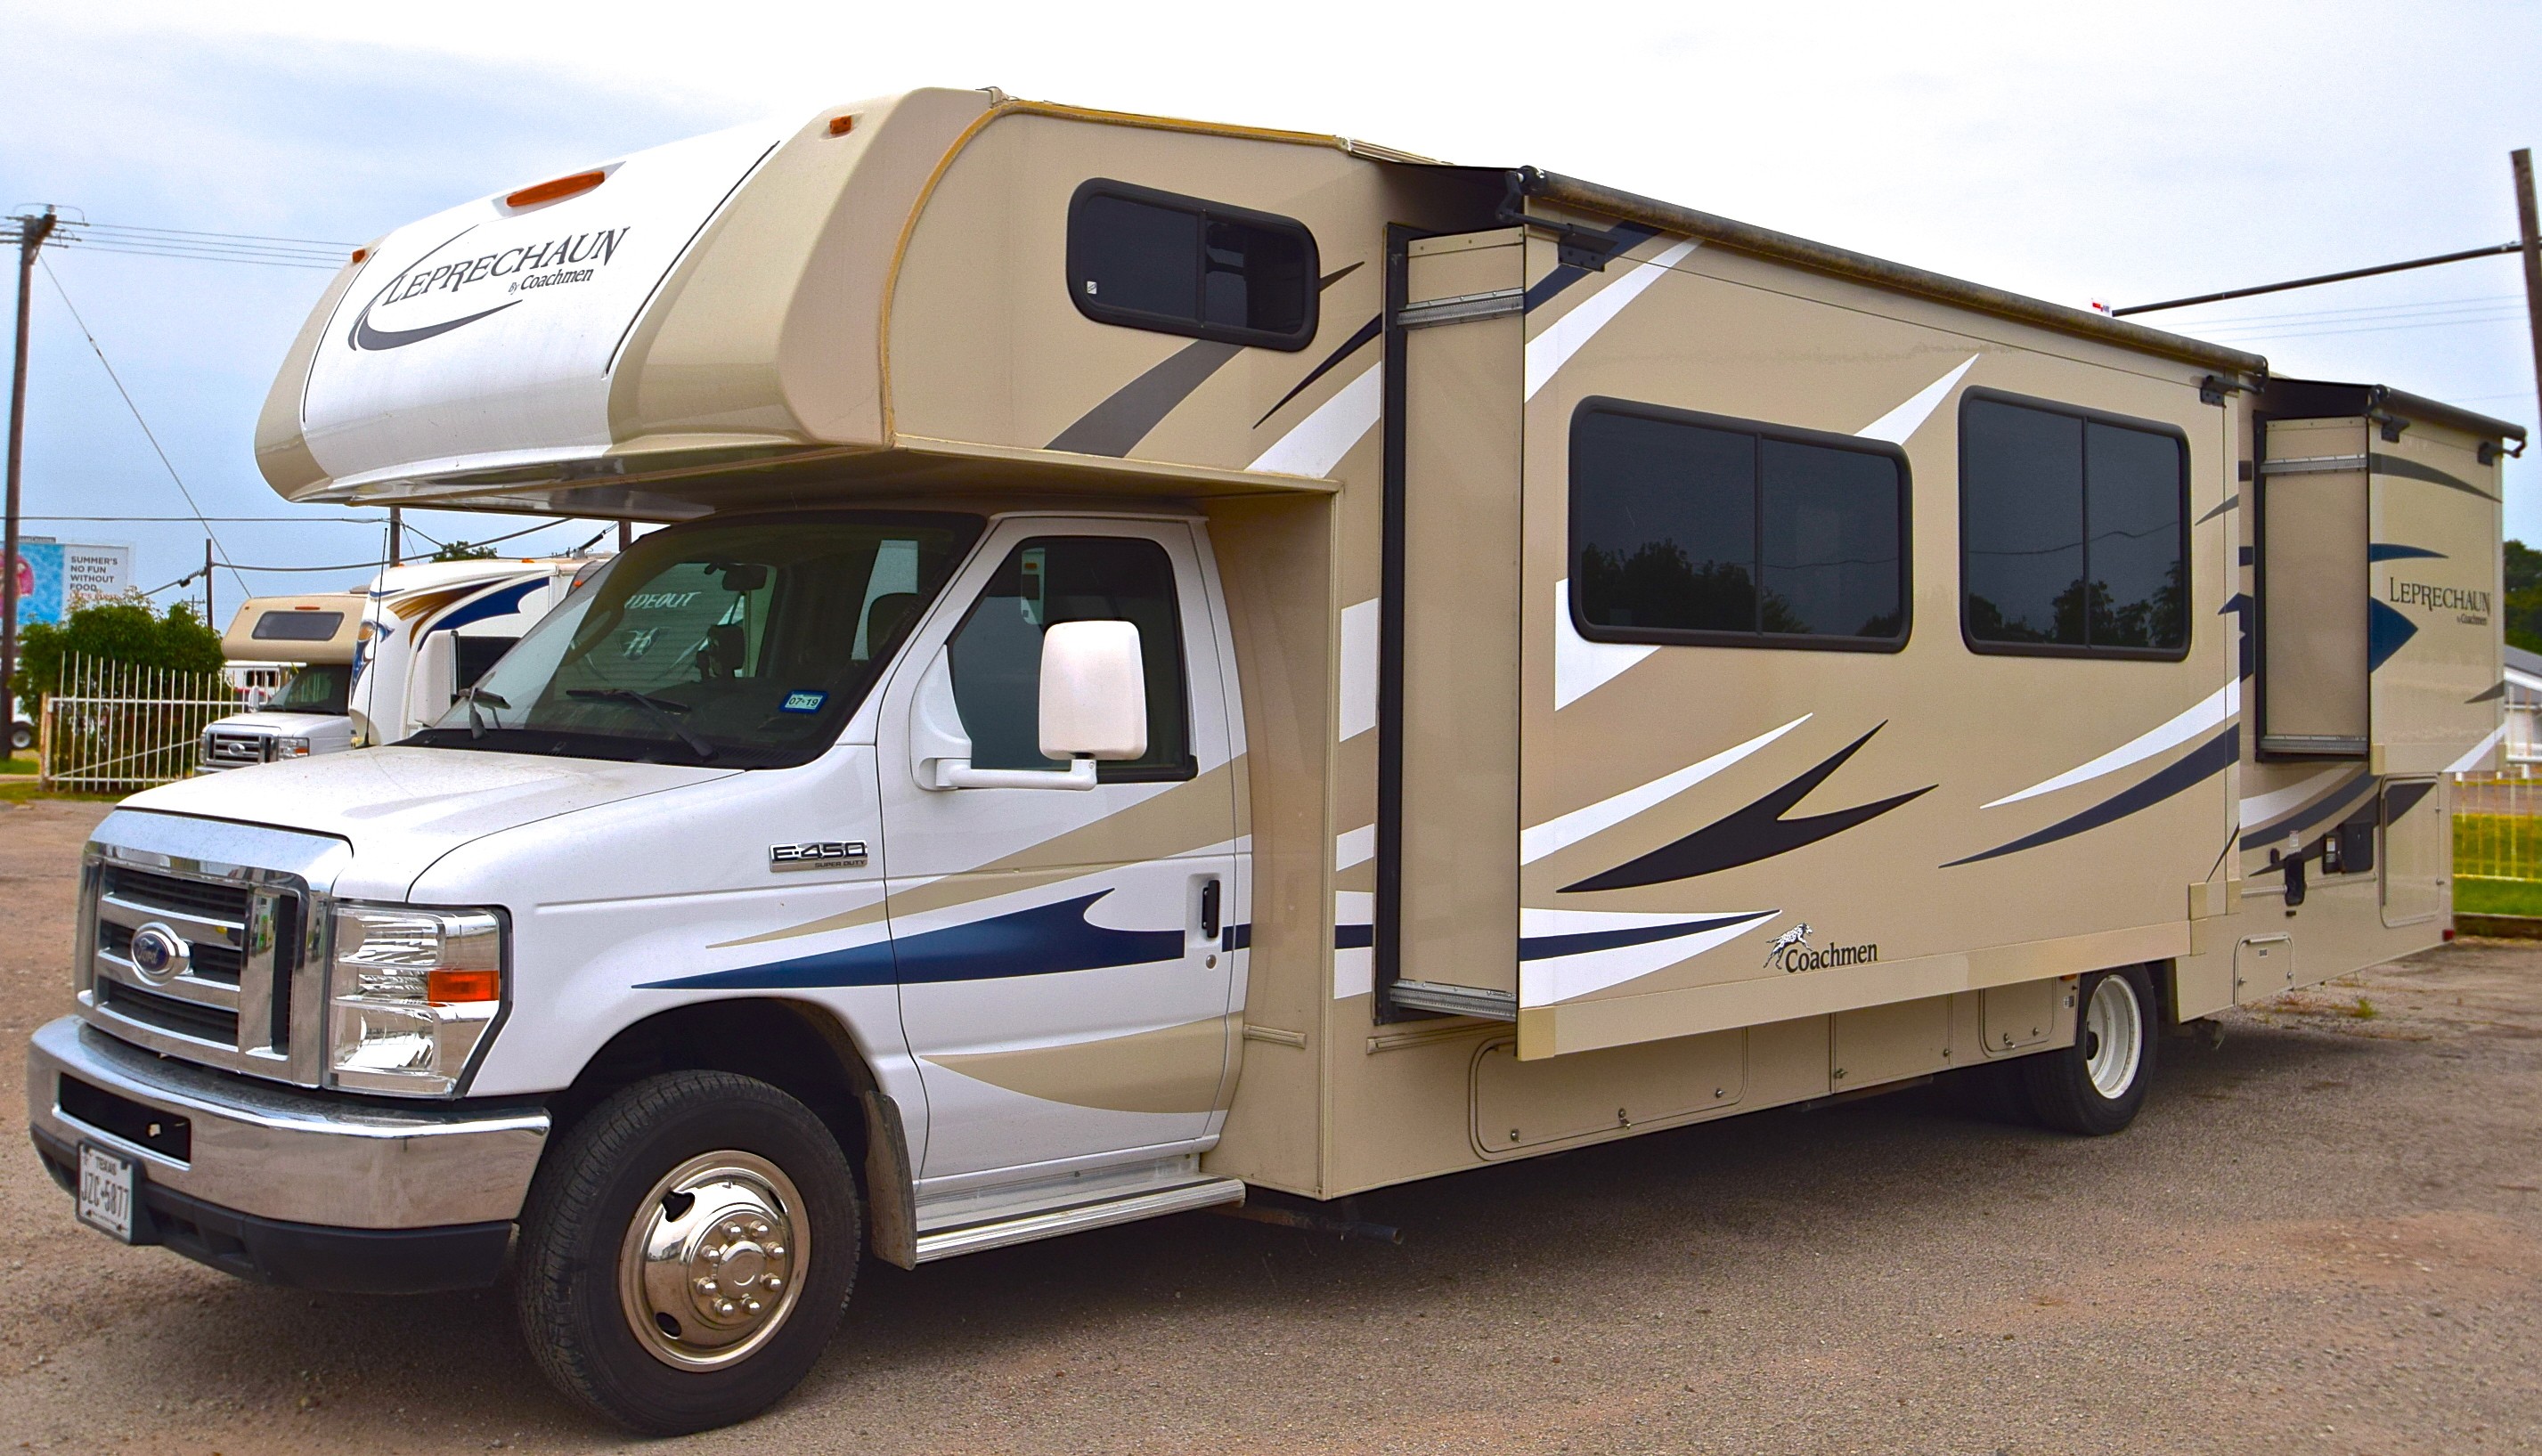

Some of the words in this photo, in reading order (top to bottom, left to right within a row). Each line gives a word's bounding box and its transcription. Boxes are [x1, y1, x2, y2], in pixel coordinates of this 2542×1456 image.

[382, 226, 631, 306] LEPRECHAUN
[520, 268, 595, 290] Coachmen
[71, 556, 118, 565] SUMMER'S
[87, 565, 107, 573] FUN
[70, 574, 115, 583] WITHOUT
[624, 592, 702, 610] IDEOUT
[2390, 577, 2491, 616] LEPRECHAUN
[770, 841, 868, 862] E-450
[1785, 942, 1878, 973] Coachmen
[95, 1156, 118, 1176] TEXAS
